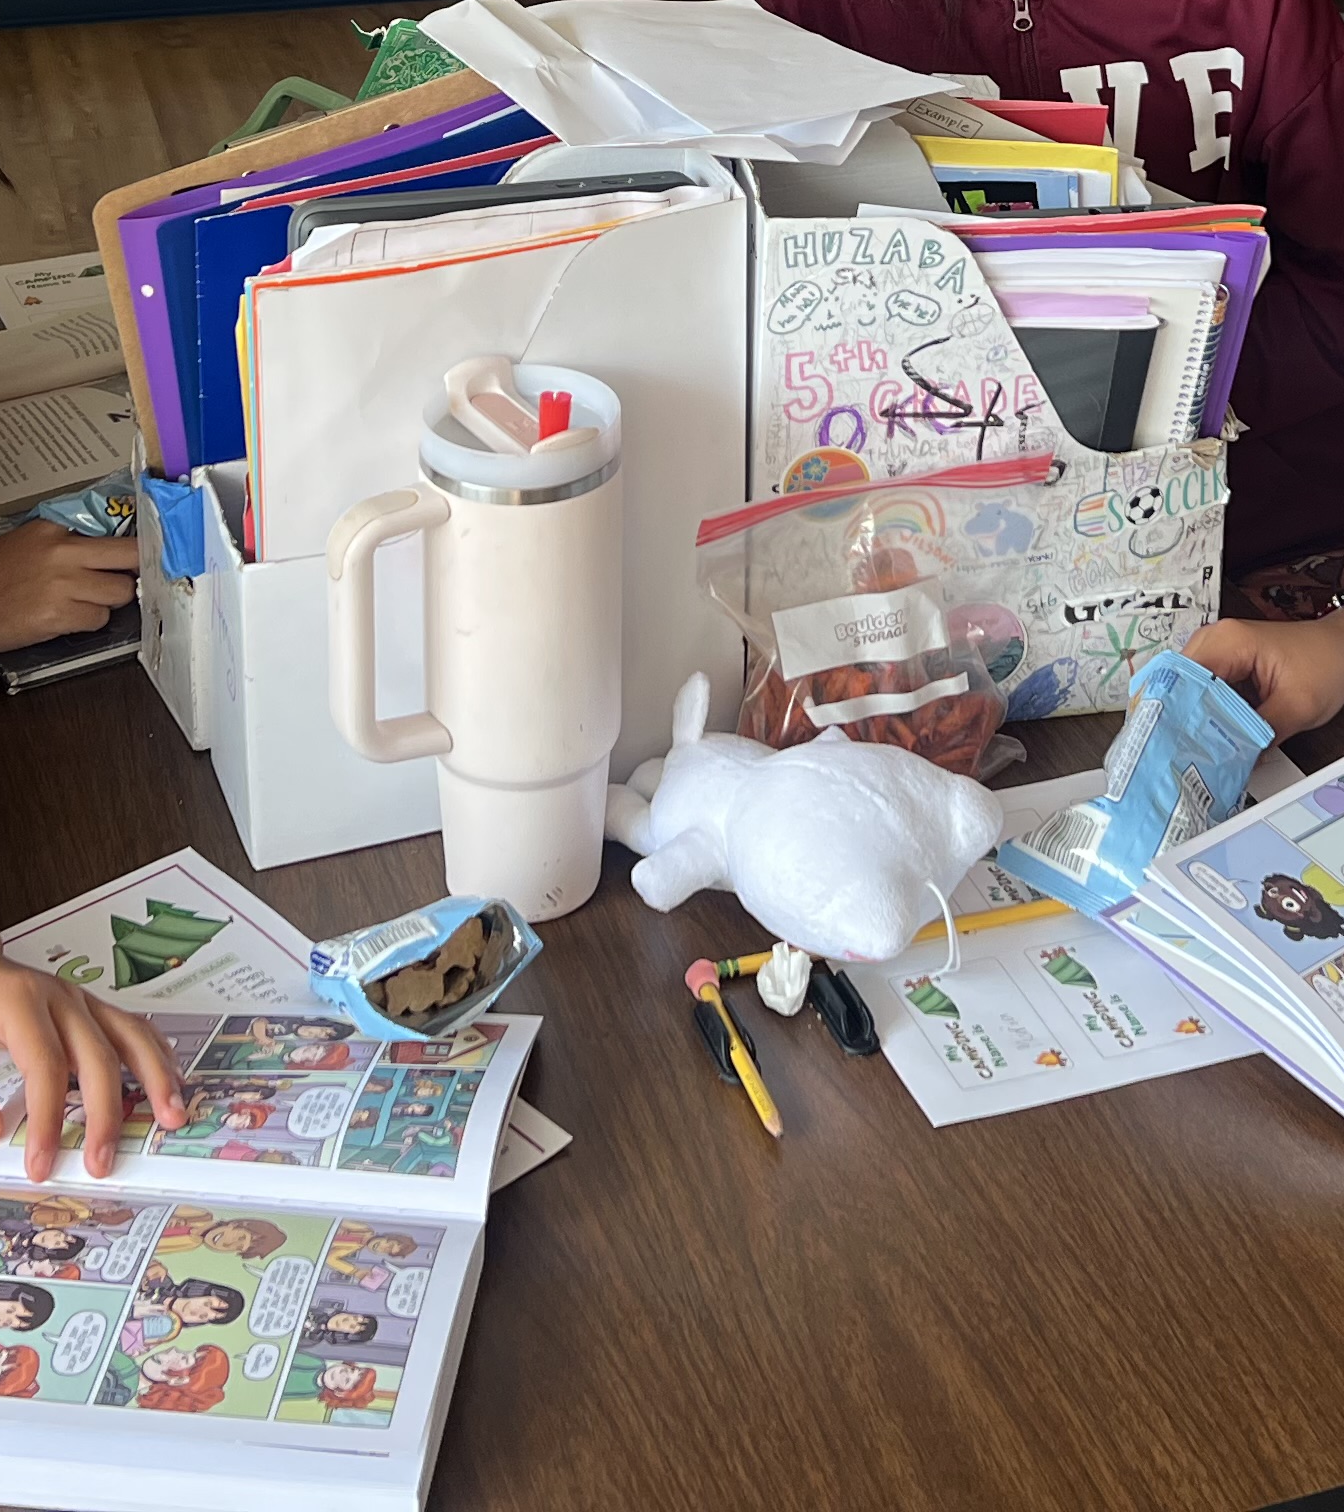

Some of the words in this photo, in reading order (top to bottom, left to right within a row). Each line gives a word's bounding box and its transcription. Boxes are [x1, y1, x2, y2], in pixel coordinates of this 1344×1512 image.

[784, 228, 966, 294] HUZABA
[15, 273, 76, 286] CAMPING
[783, 340, 887, 423] 5th
[835, 610, 903, 642] Boulder
[854, 623, 908, 648] STORAGE
[1110, 994, 1123, 1004] is
[971, 1024, 985, 1036] is
[1083, 1014, 1102, 1032] My
[1085, 991, 1134, 1048] CAMPING
[1119, 1004, 1147, 1037] Name
[944, 1044, 962, 1063] My
[945, 1021, 993, 1079] CAMPING
[980, 1034, 1007, 1068] Name
